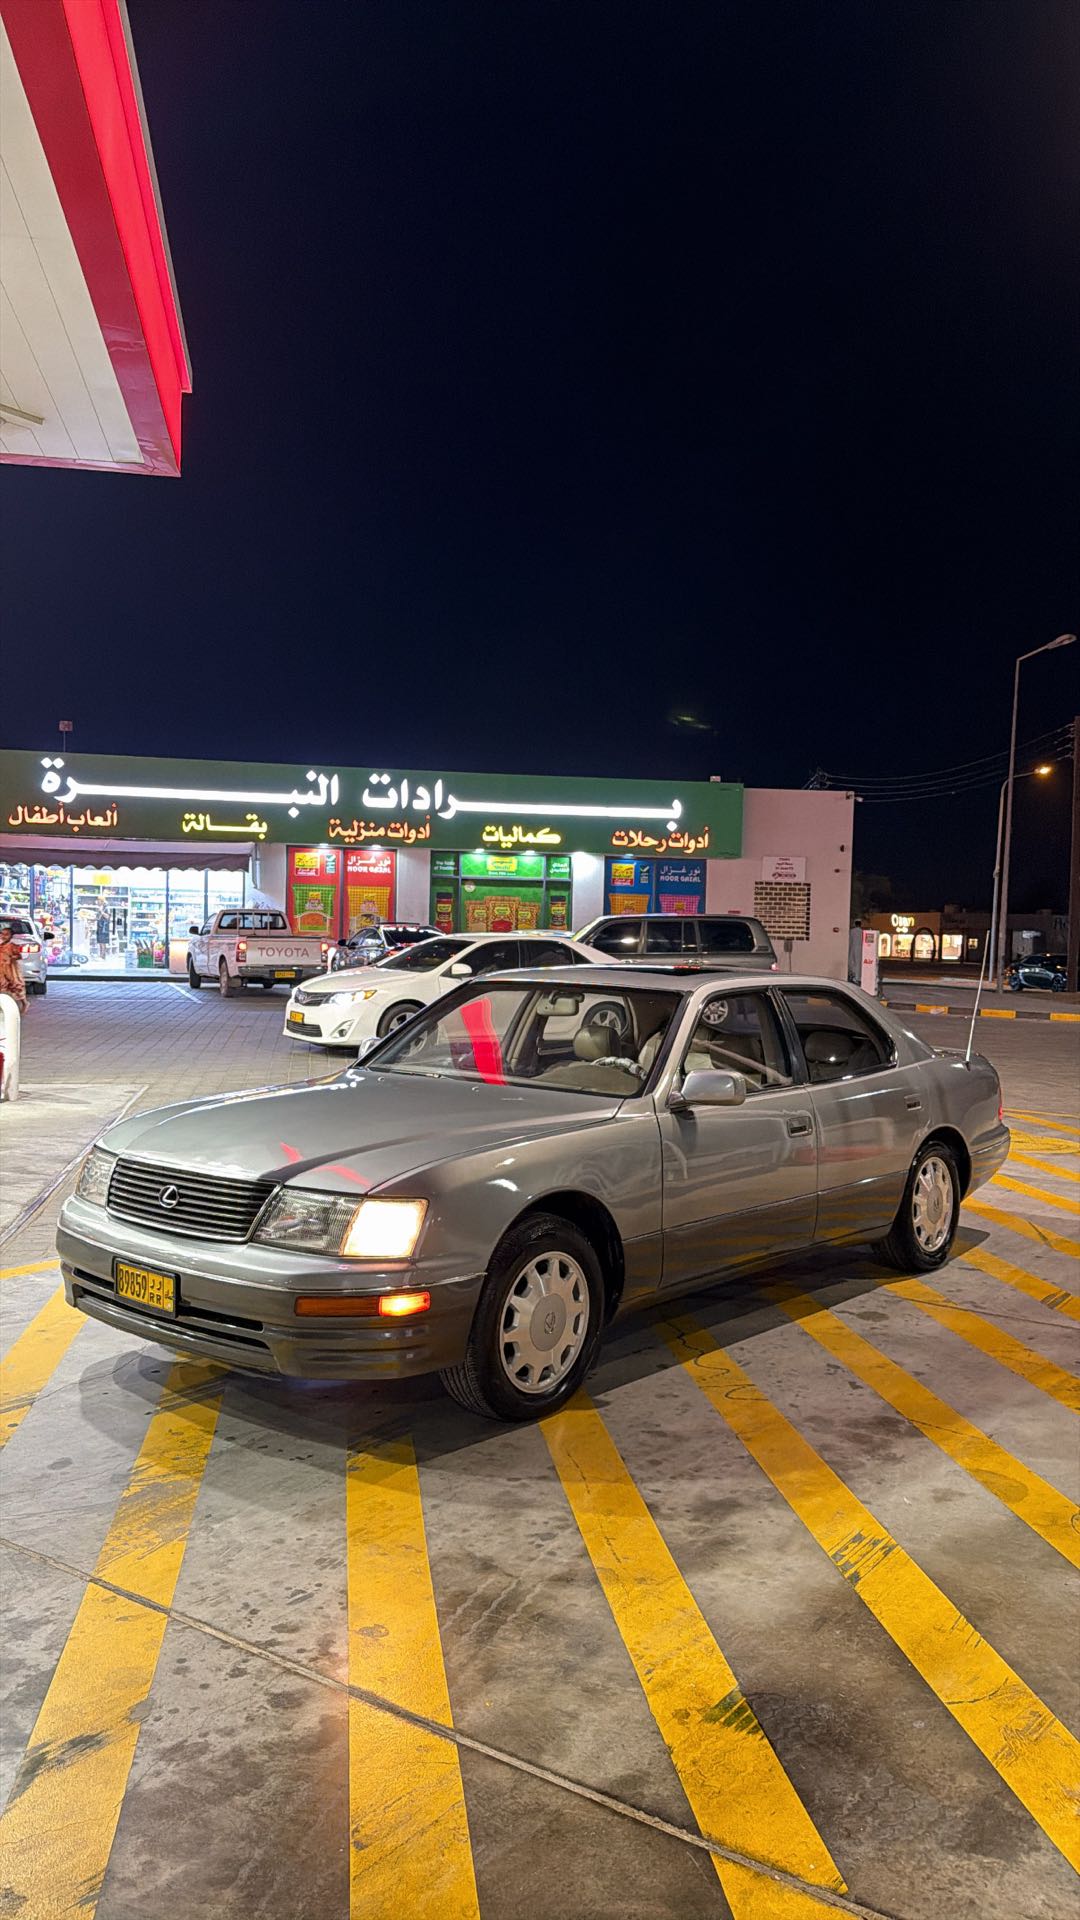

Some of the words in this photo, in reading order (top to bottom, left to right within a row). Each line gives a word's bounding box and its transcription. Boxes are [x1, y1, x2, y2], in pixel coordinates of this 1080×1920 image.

[8, 801, 64, 826] أطفال
[67, 803, 117, 832] ألعاب
[182, 813, 268, 839] بقالة
[328, 817, 386, 844] منزلية
[387, 816, 430, 843] أدوات
[482, 825, 561, 848] كماليات
[611, 830, 667, 852] رحلات
[668, 827, 709, 854] أدوات
[660, 865, 686, 875] غزال
[689, 866, 700, 876] نور
[257, 947, 309, 958] TOYOTA
[118, 1268, 147, 1300] 89859
[149, 1292, 162, 1305] RR
